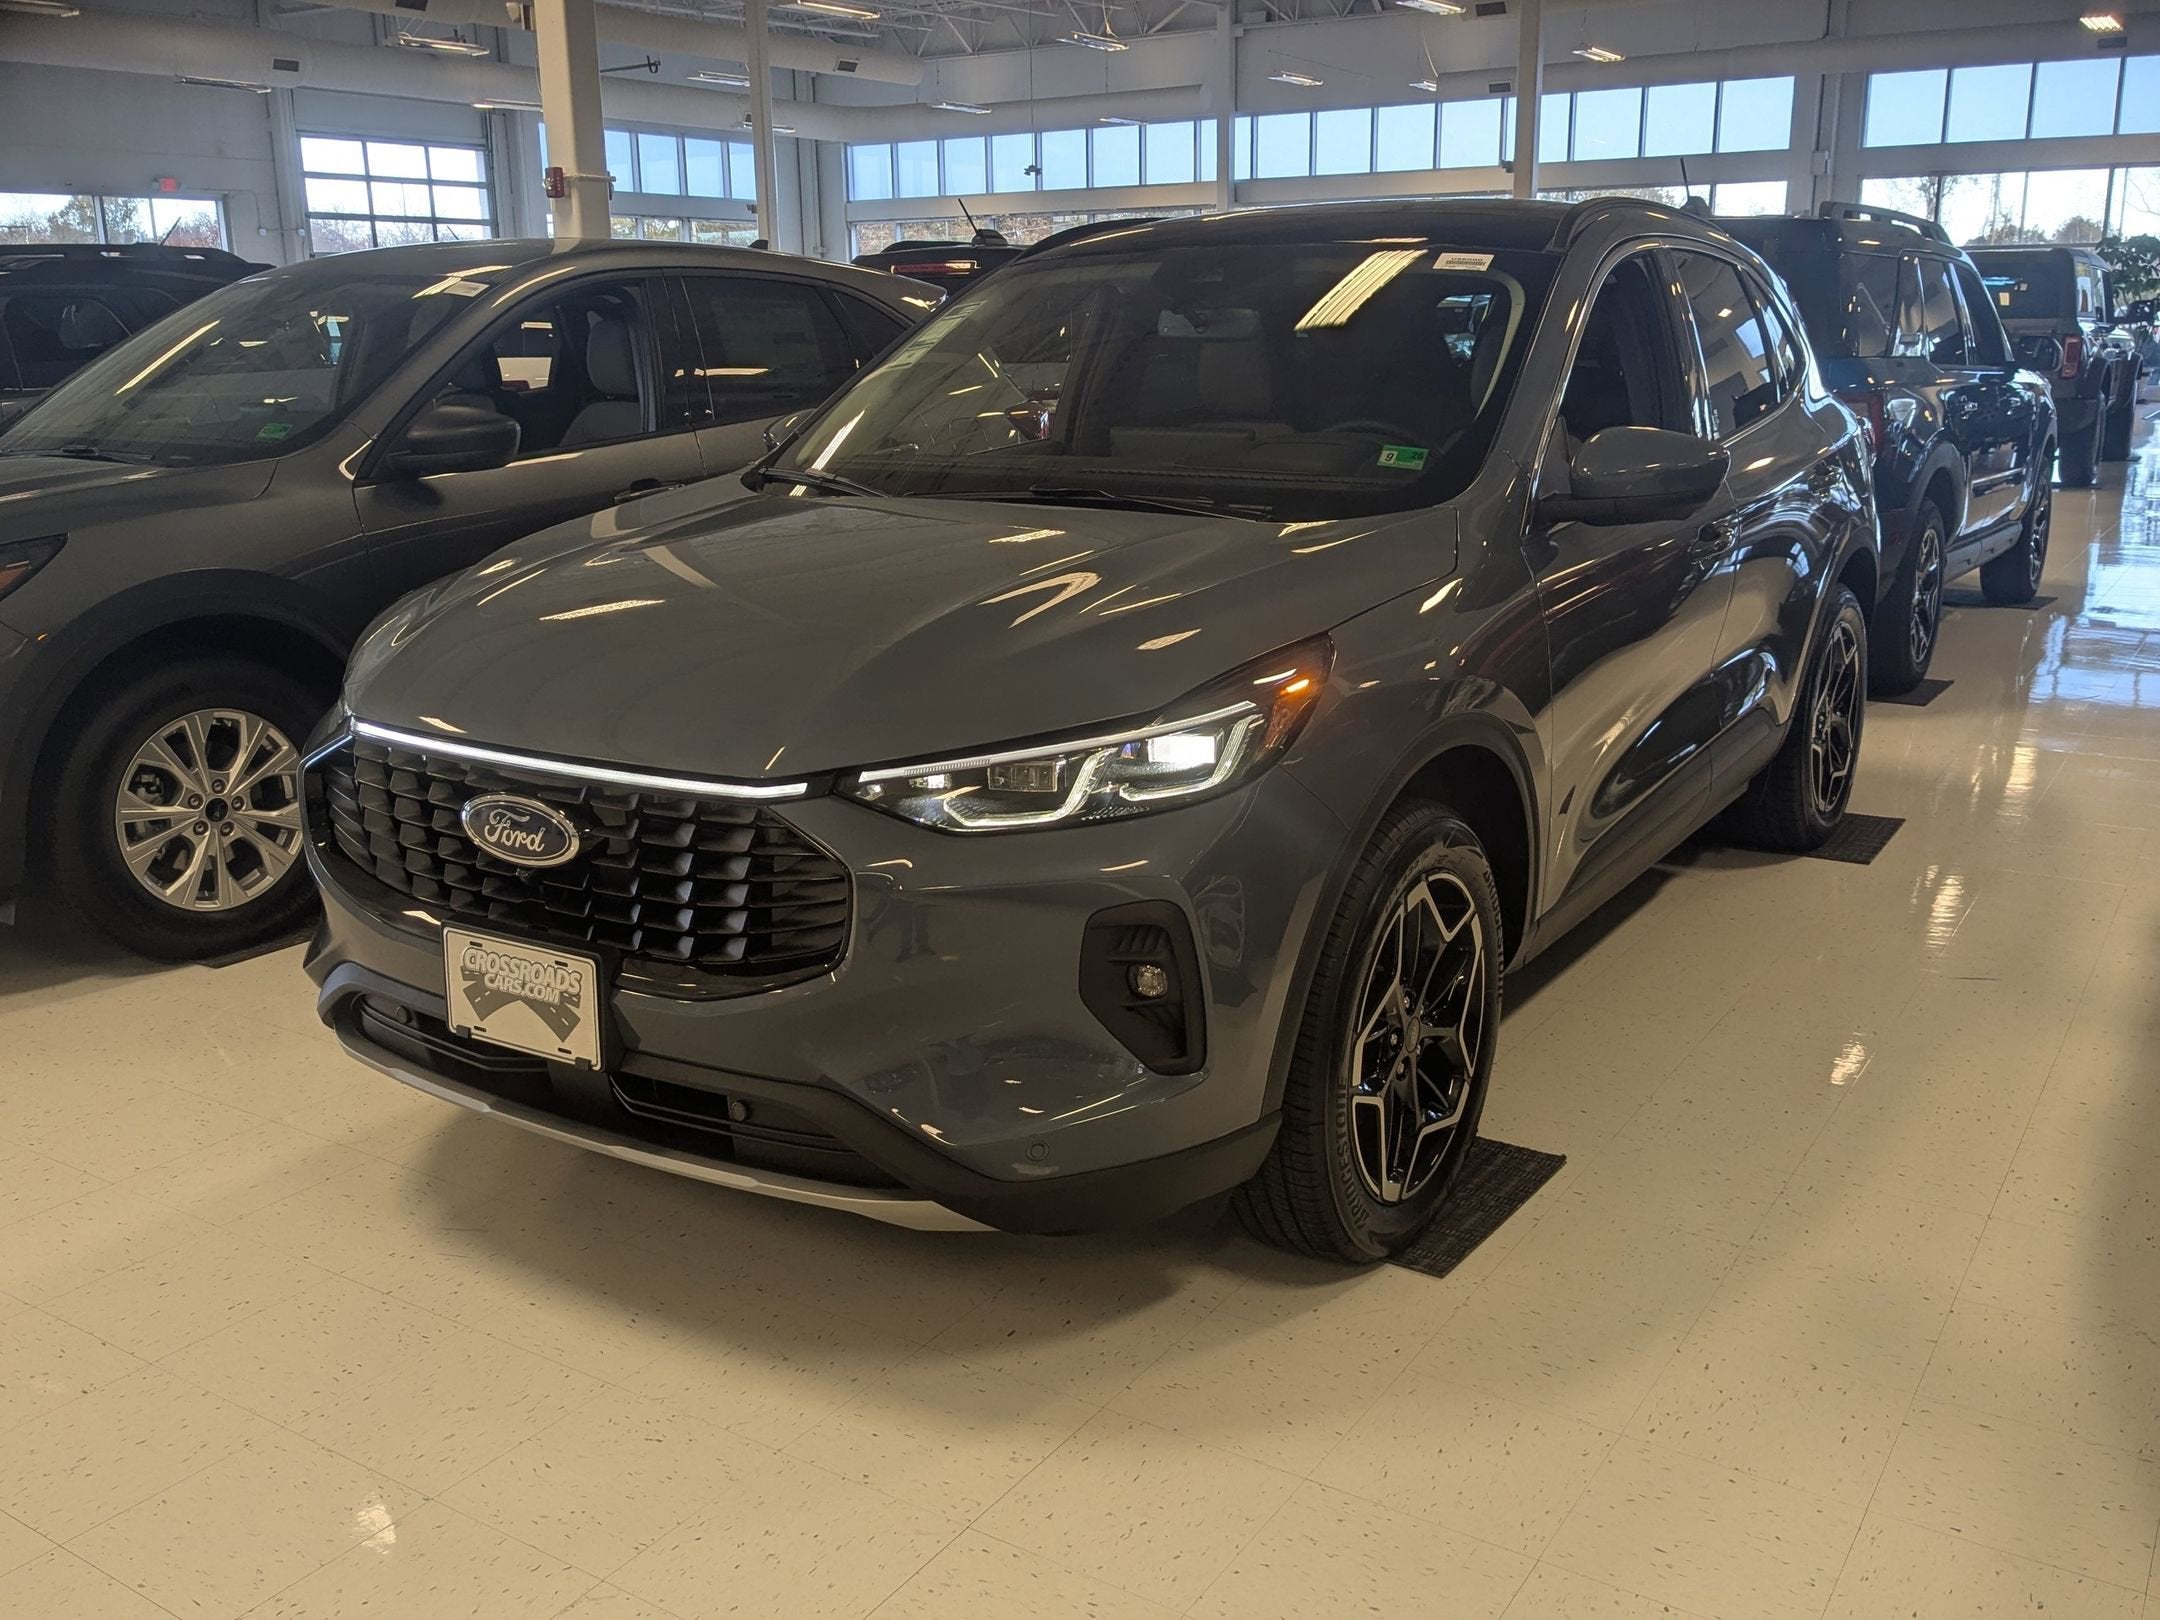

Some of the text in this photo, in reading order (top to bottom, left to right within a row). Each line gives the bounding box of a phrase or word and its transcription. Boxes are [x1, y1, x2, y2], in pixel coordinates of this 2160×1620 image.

[1384, 452, 1395, 462] 9
[484, 808, 546, 852] Ford
[462, 946, 583, 996] CROSSROADS
[484, 972, 561, 1005] CARS.COM
[1335, 1076, 1370, 1230] BRIDGESTONE
